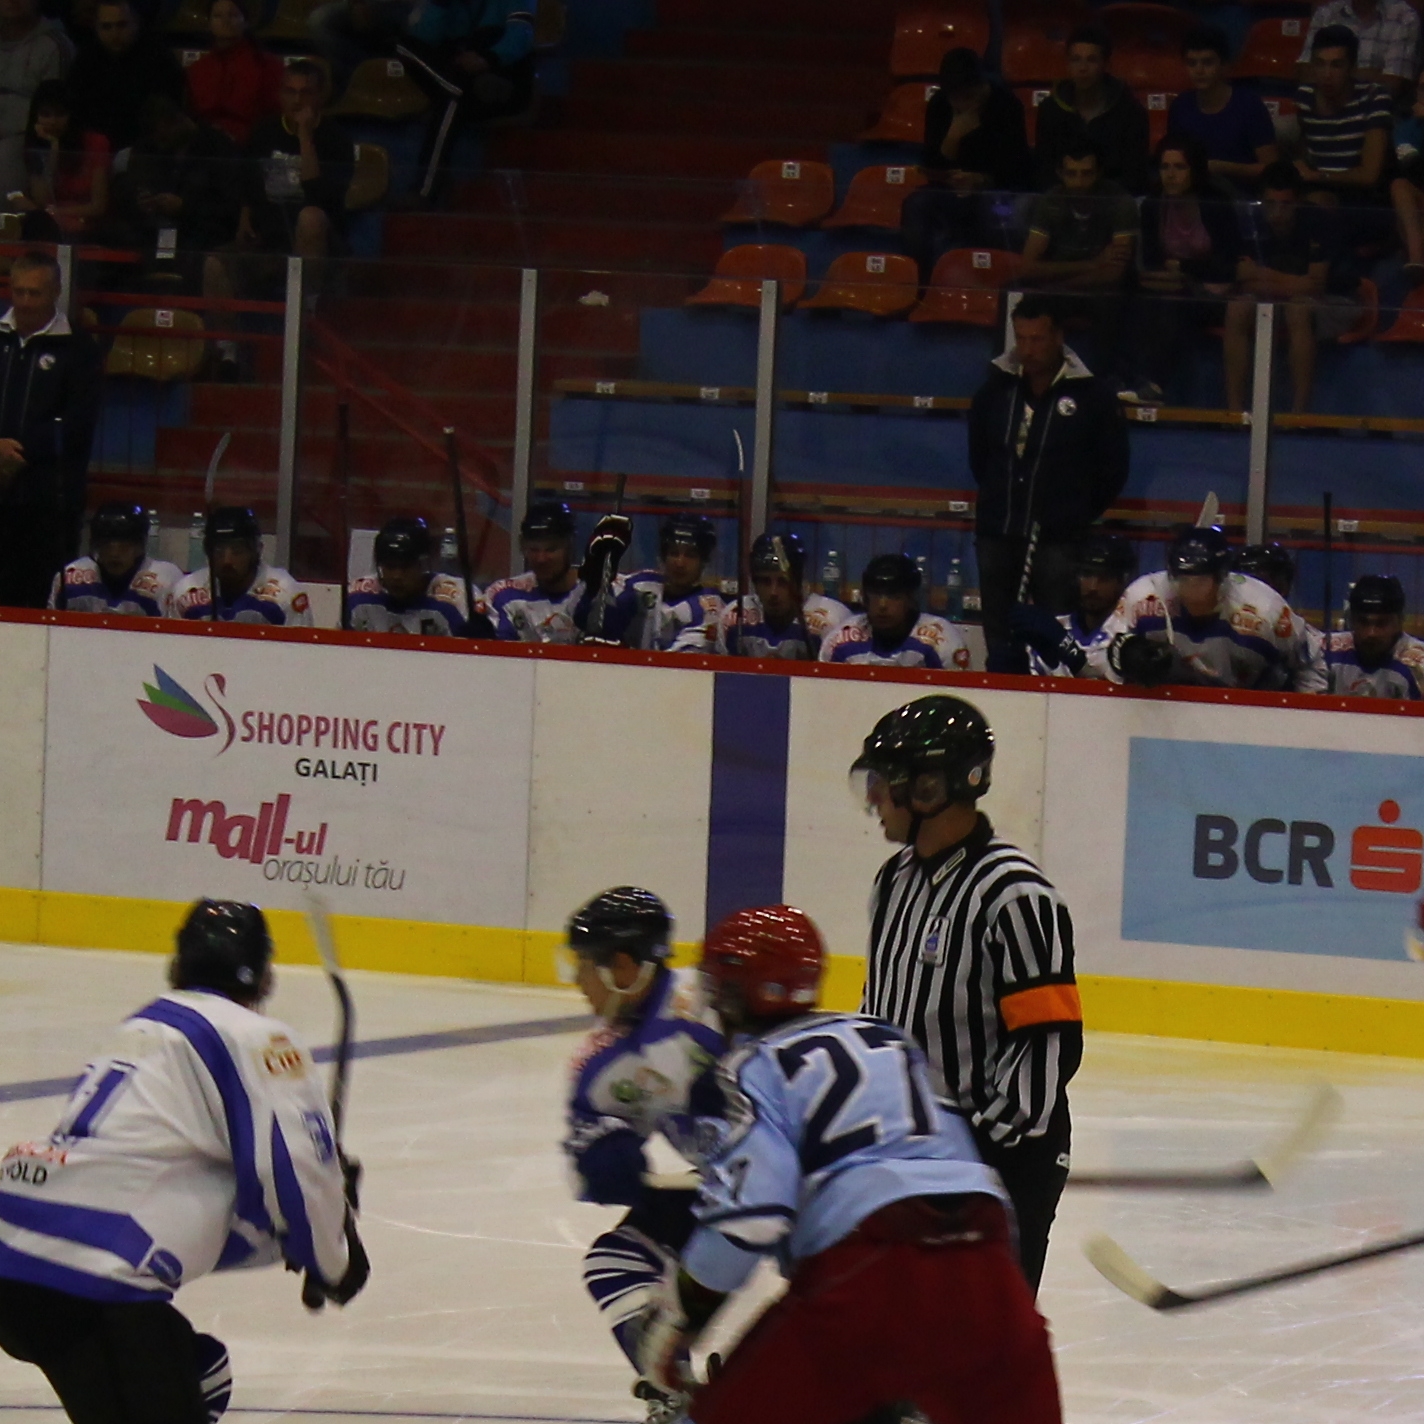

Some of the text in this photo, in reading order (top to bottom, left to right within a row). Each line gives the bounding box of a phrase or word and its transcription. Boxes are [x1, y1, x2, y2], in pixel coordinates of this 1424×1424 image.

[240, 710, 446, 756] SHOPPING CITY
[1193, 814, 1334, 888] BCR
[364, 860, 406, 891] tău
